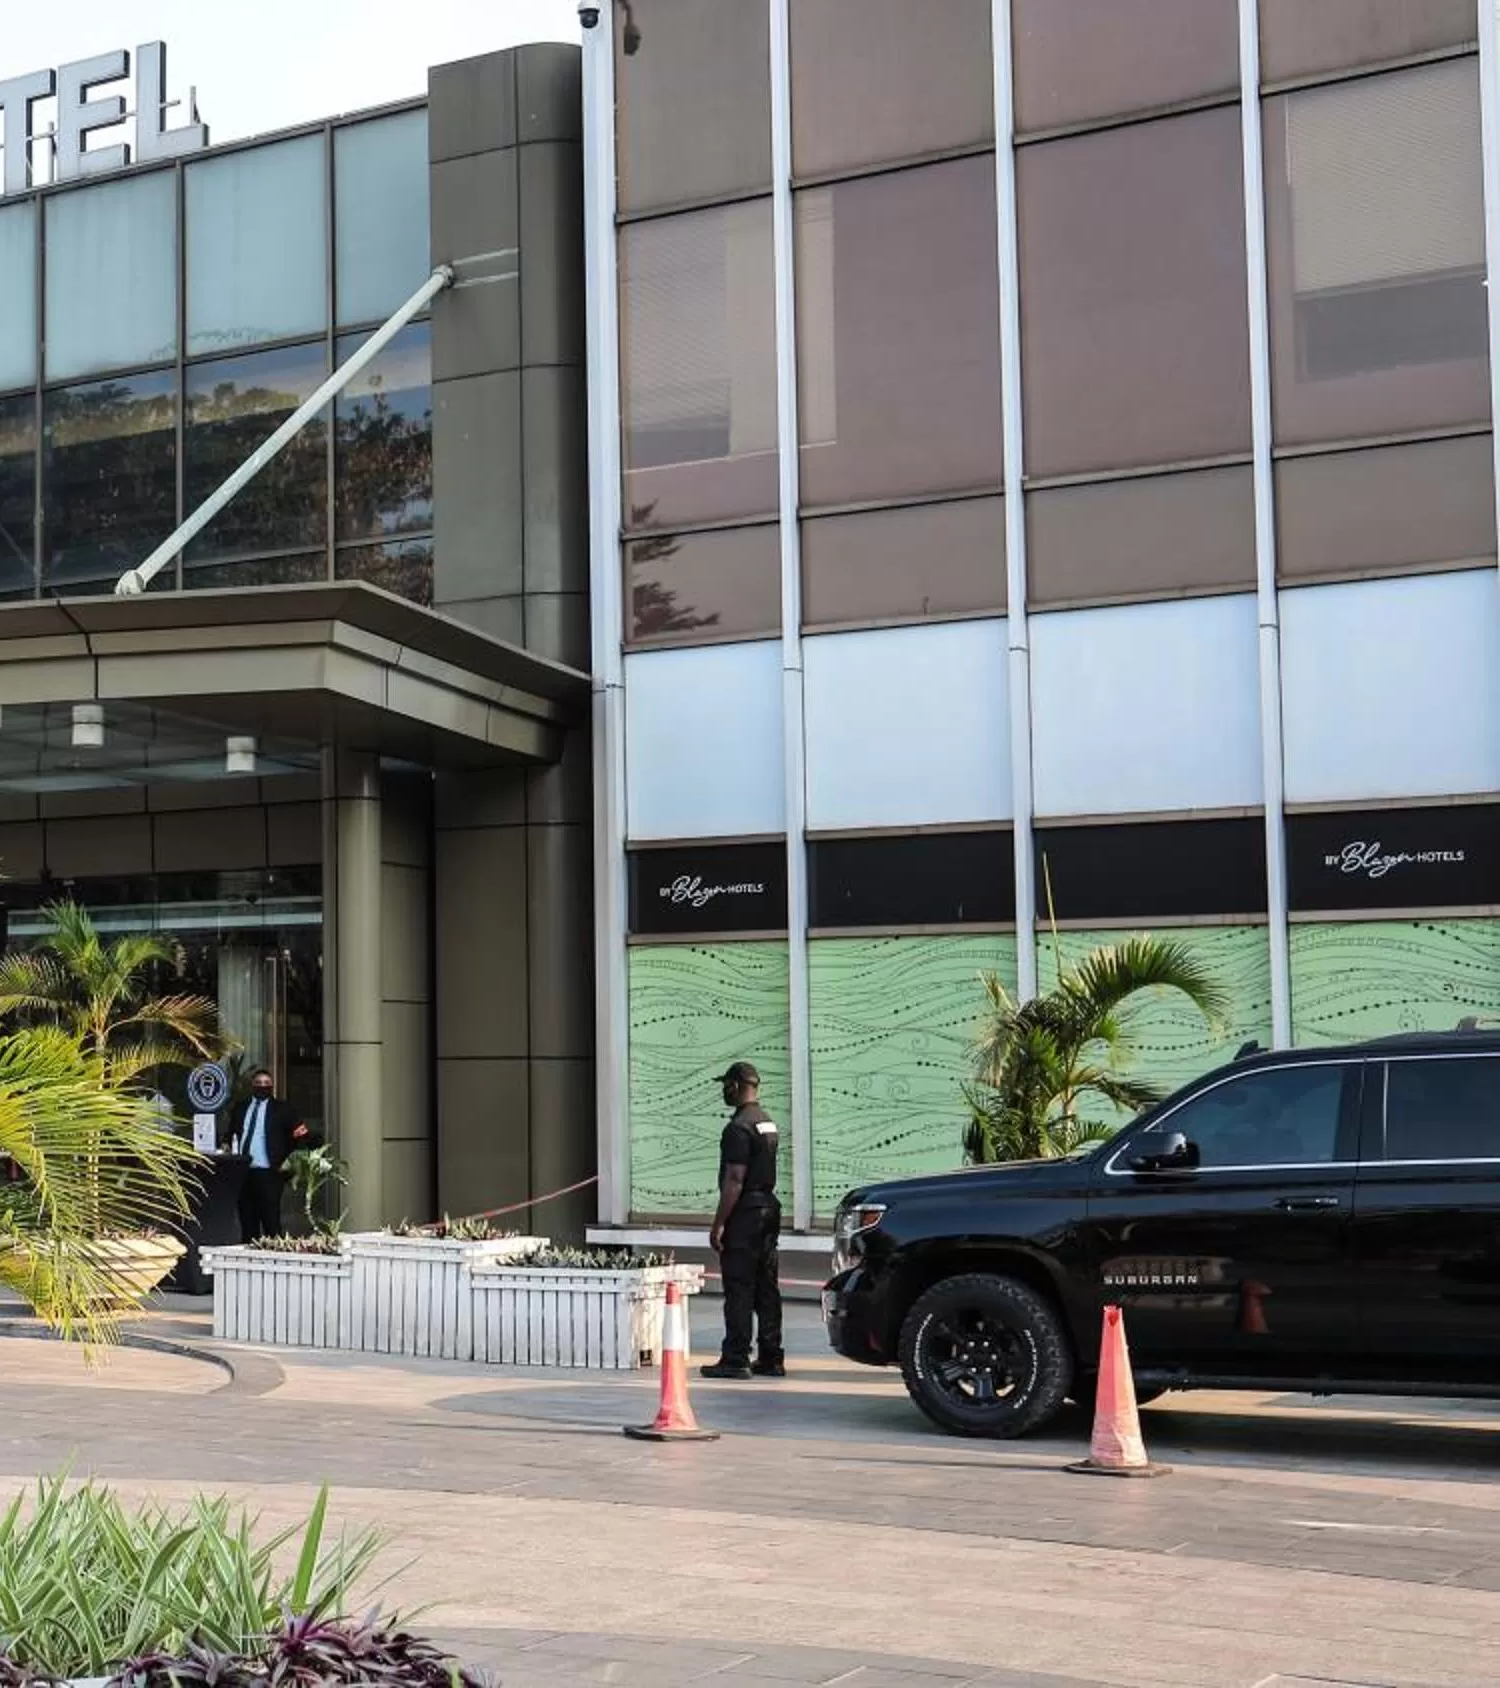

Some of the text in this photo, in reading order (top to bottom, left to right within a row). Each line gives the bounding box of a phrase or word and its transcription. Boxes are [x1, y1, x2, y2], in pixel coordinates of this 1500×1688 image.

[1325, 854, 1340, 866] BY
[1416, 850, 1465, 863] HOTELS
[727, 883, 764, 894] HOTELS
[1103, 1275, 1198, 1285] SUBURBAN
